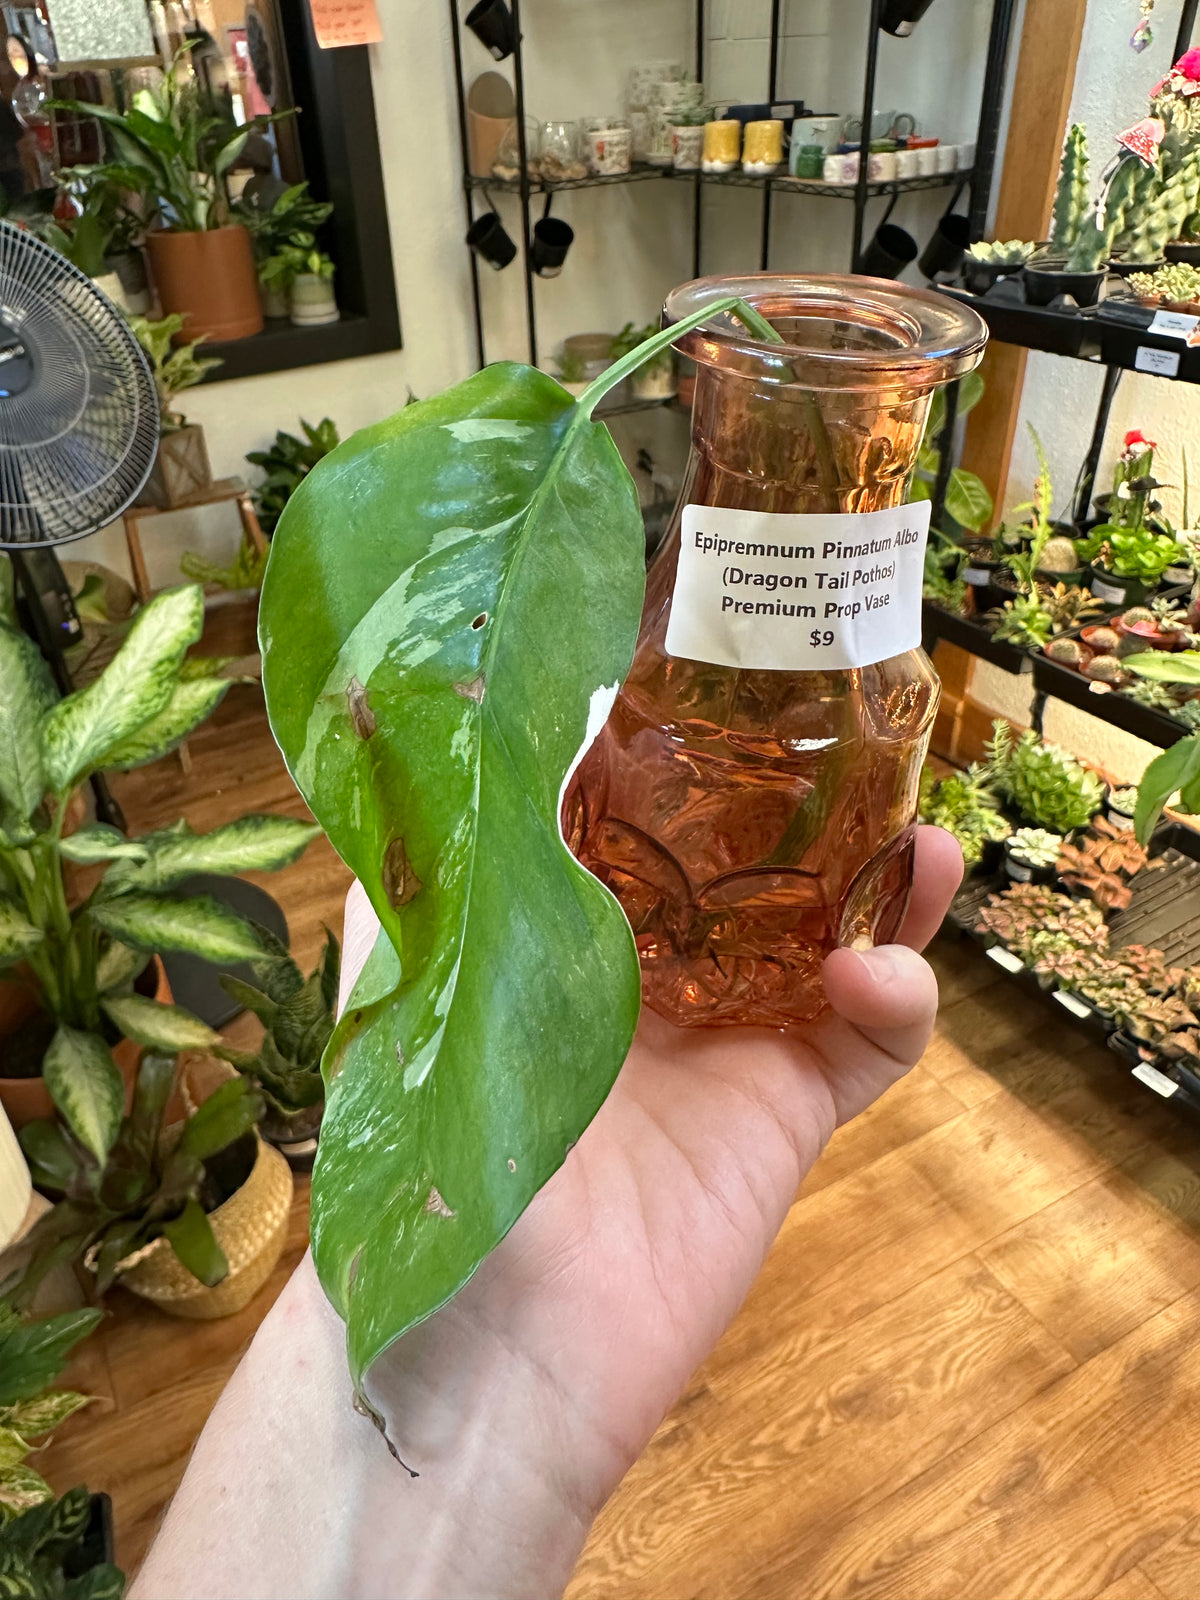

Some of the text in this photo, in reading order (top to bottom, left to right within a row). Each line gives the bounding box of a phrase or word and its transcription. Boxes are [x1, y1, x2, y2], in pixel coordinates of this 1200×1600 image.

[695, 528, 919, 560] Epipremnum Pinnatum Albo
[722, 561, 896, 591] (Dragon Tail Pothos)
[721, 592, 890, 620] Premium Prop Vase
[809, 628, 835, 648] $9
